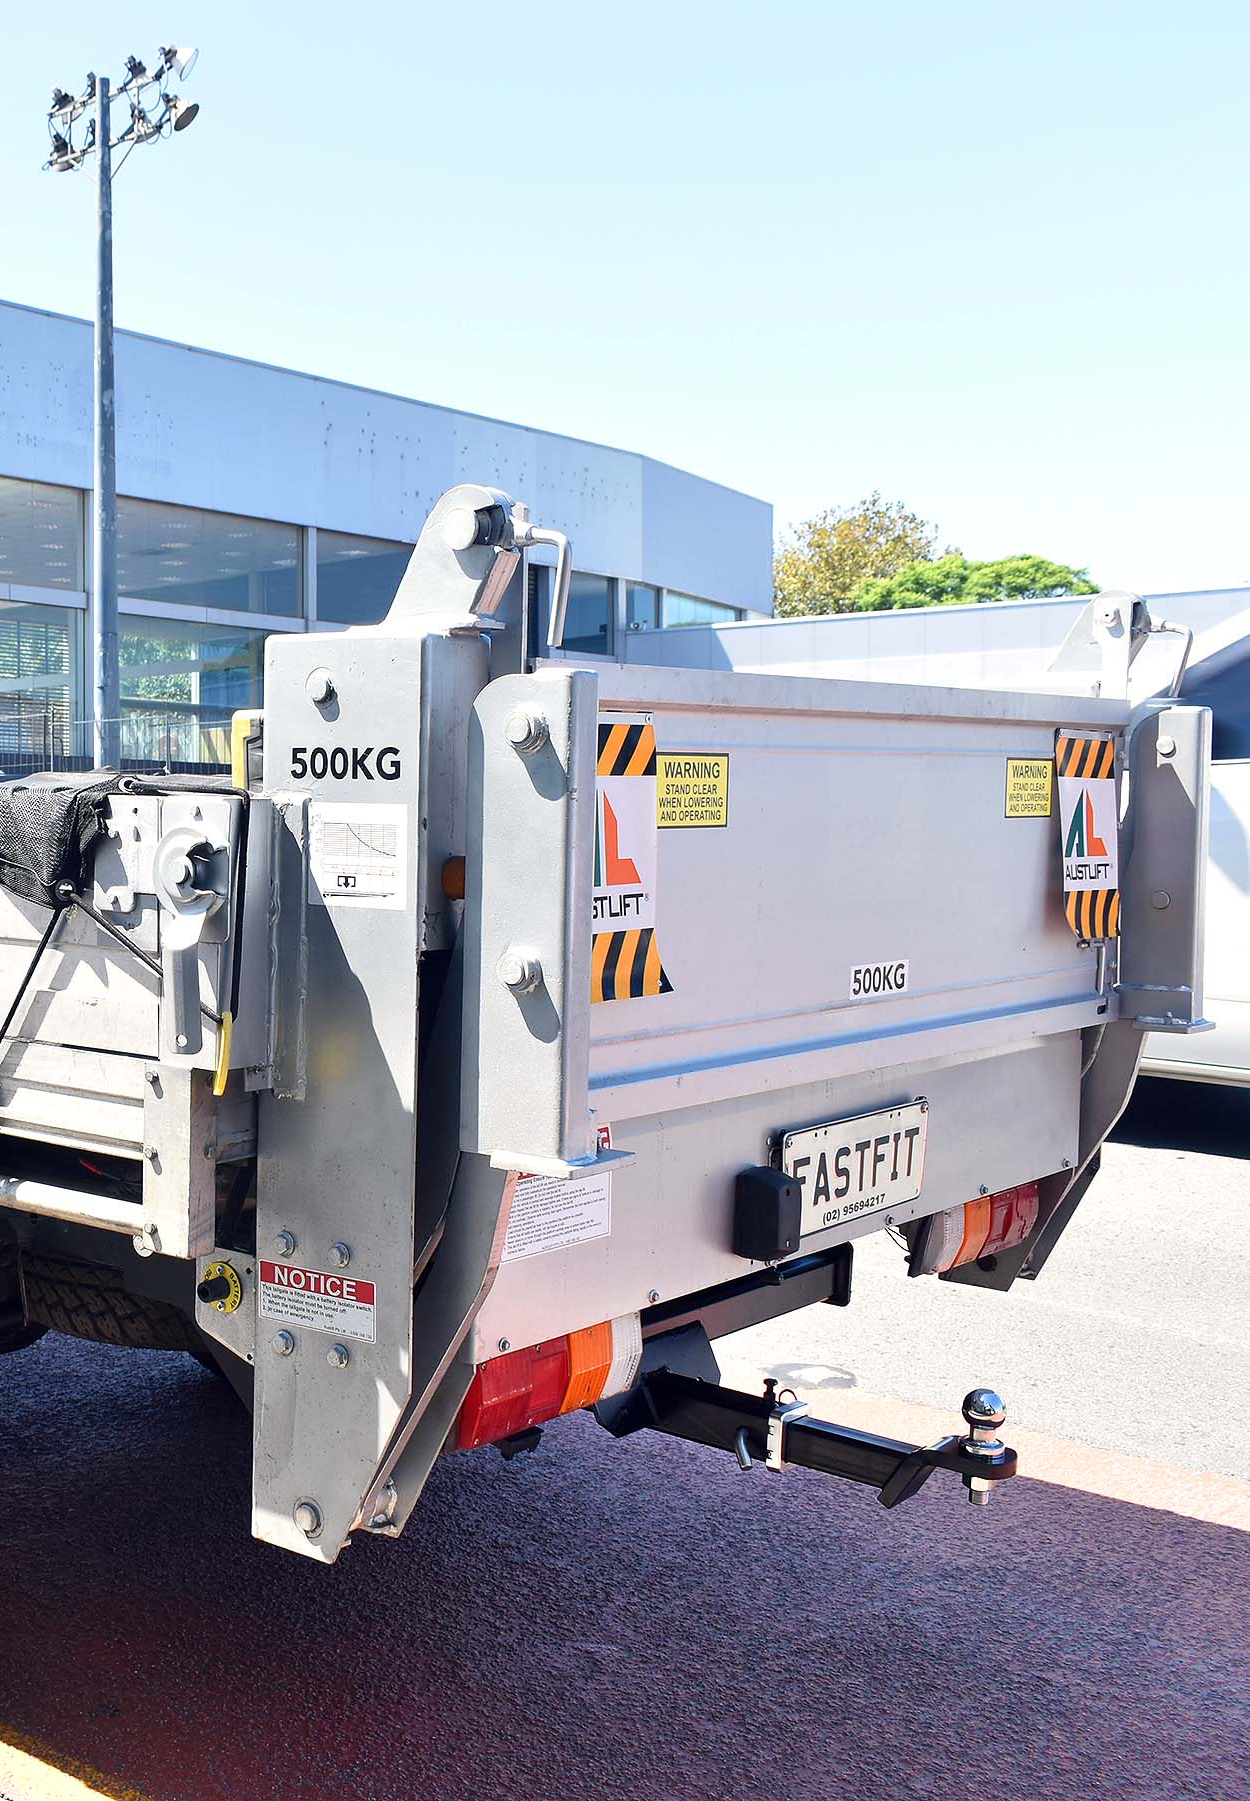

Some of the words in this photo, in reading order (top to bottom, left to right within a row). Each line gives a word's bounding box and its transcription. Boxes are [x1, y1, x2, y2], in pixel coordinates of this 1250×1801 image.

[290, 747, 401, 780] 500KG
[664, 761, 721, 779] WARNING
[1012, 765, 1048, 779] WARNING
[665, 784, 690, 795] STAND
[692, 784, 718, 795] CLEAR
[1012, 782, 1029, 791] STAND
[1030, 782, 1046, 791] CLEAR
[658, 797, 683, 808] WHEN
[684, 797, 724, 808] LOWERING
[1009, 793, 1023, 802] WHEN
[1023, 793, 1049, 802] LOWERING
[660, 810, 677, 821] AND
[678, 810, 722, 821] OPERATING
[1009, 803, 1020, 812] AND
[1021, 803, 1048, 812] OPERATING
[1065, 864, 1110, 880] AUSTLIFT
[852, 963, 905, 995] 500KG
[793, 1127, 920, 1206] FASTFIT
[822, 1208, 841, 1225] (02)
[843, 1194, 886, 1216] 95694217
[229, 1273, 239, 1309] BATTERY
[274, 1266, 357, 1300] NOTICE
